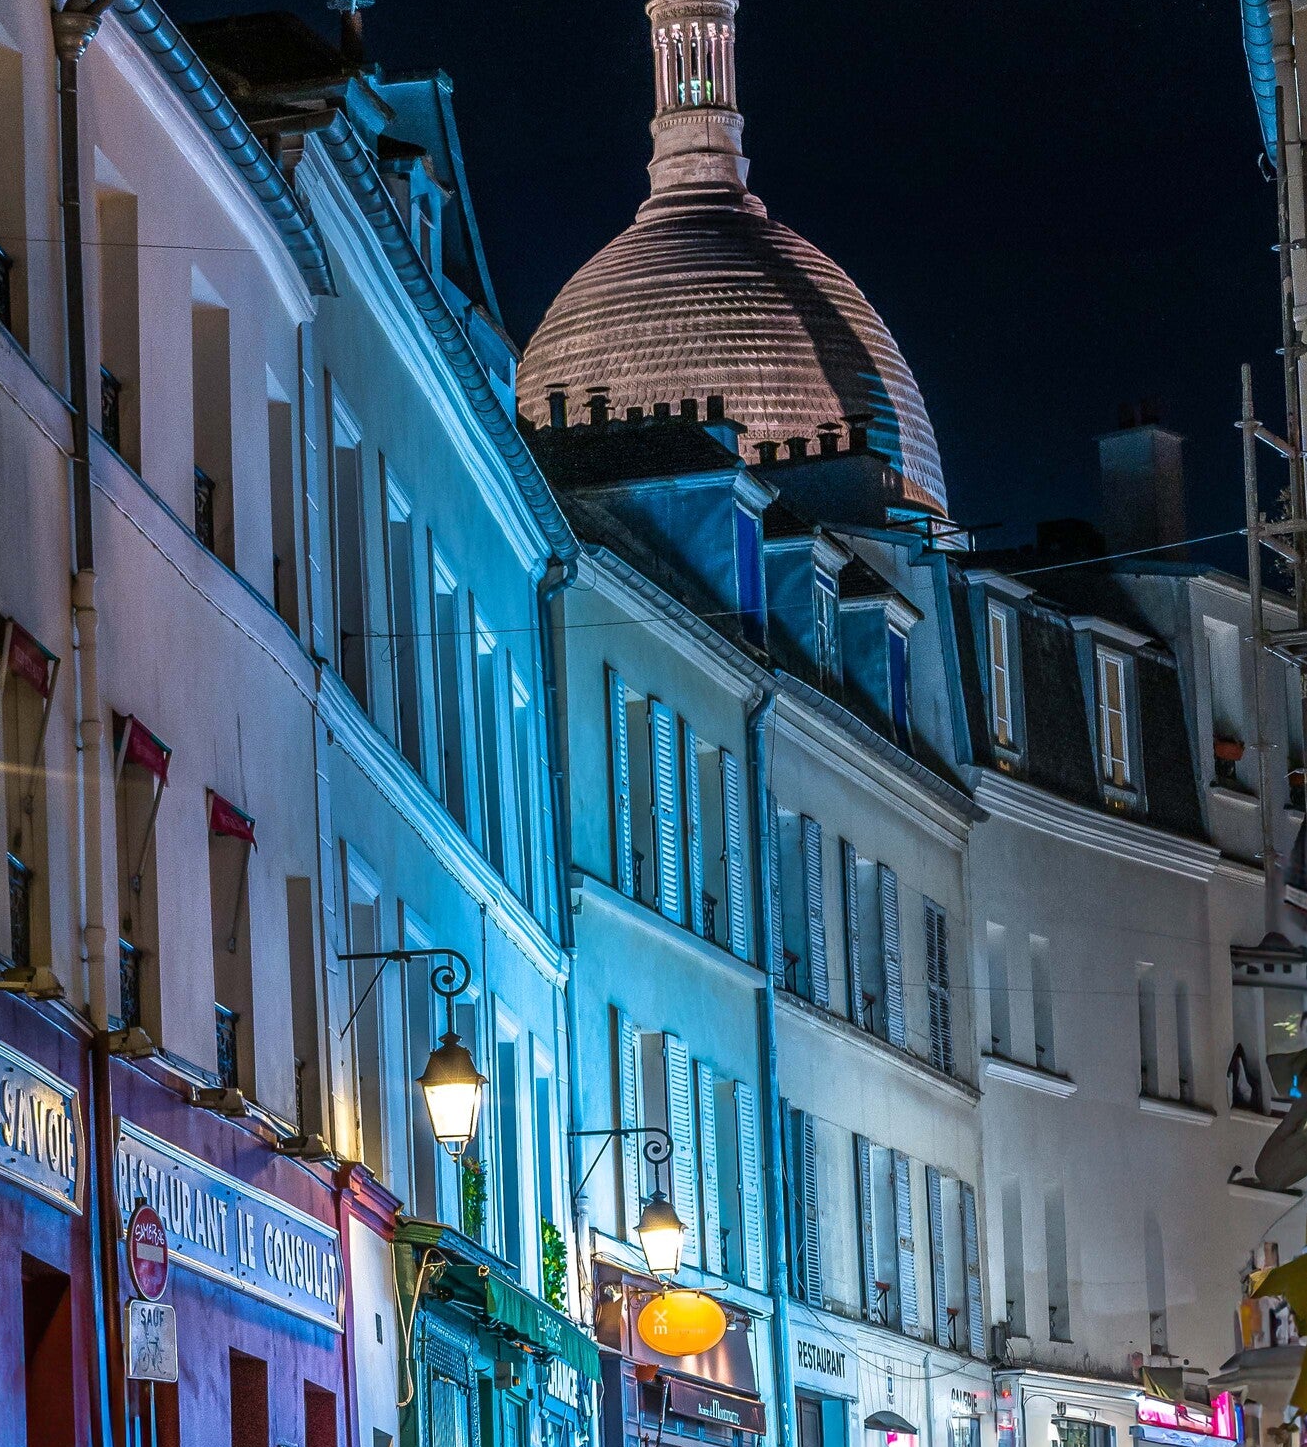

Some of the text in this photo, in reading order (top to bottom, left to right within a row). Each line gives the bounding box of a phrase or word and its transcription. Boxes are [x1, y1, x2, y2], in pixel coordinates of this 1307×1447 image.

[1, 1074, 76, 1183] SAVOIE
[117, 1149, 337, 1306] RESTAURANT LE CONSULAT
[140, 1307, 165, 1328] SAUF
[797, 1339, 846, 1379] RESTAURANT
